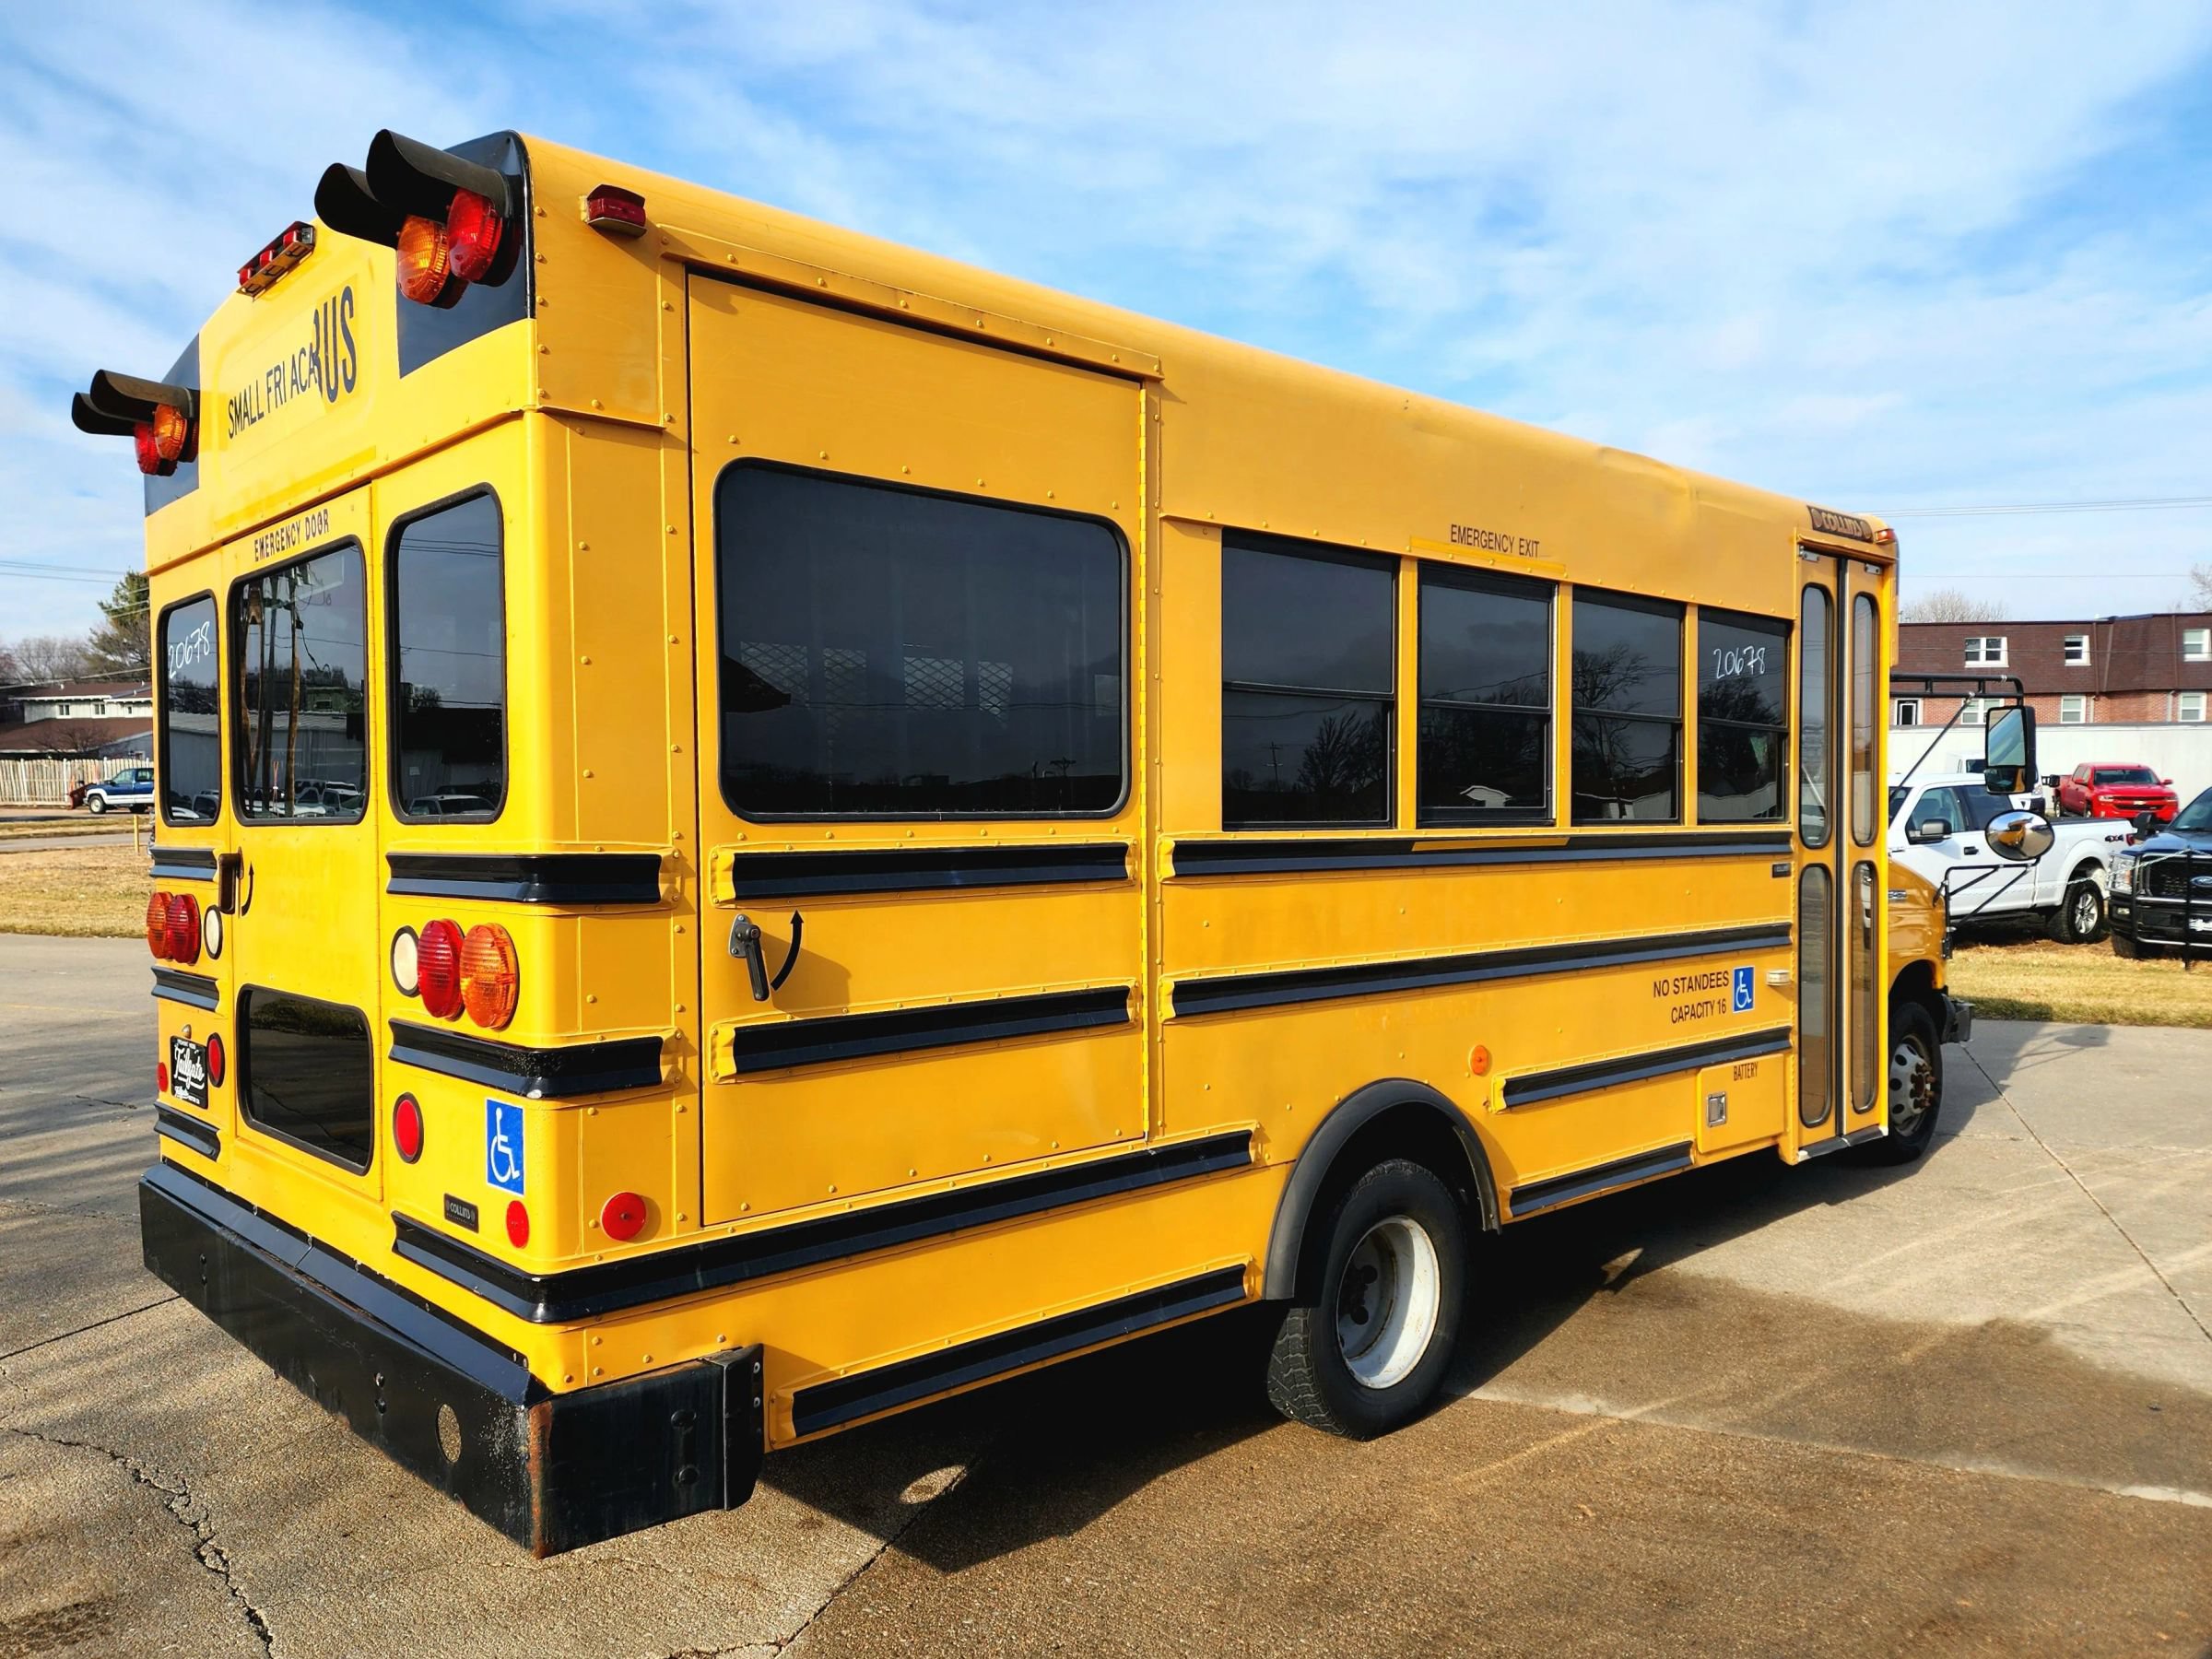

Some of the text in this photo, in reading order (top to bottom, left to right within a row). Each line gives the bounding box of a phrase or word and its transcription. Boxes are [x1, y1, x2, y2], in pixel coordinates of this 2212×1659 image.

[228, 379, 265, 440] SMALL
[265, 360, 287, 414] FRI
[253, 508, 329, 562] EMERGENCY DOOR
[1451, 524, 1539, 558] EMERGENCY EXIT
[168, 620, 210, 679] 20678
[1712, 645, 1766, 679] 20678
[1653, 971, 1730, 998] NO STANDEES
[1671, 998, 1727, 1024] CAPACITY 16
[1733, 1061, 1759, 1082] BATTERY
